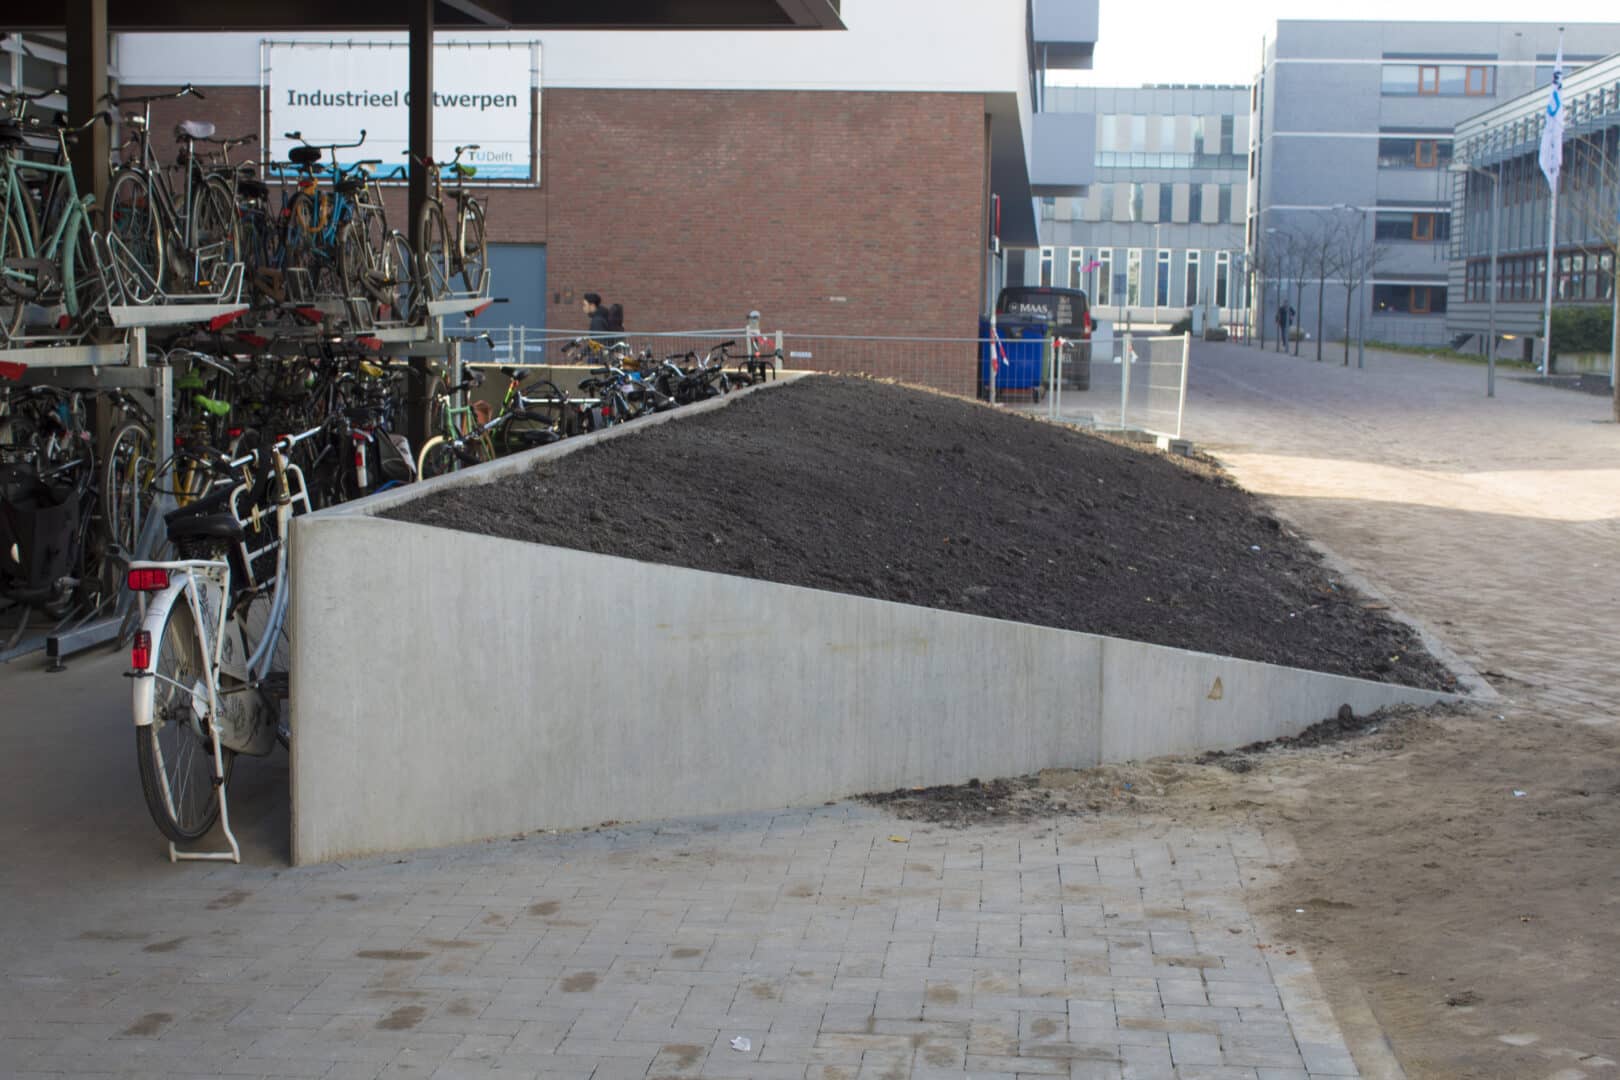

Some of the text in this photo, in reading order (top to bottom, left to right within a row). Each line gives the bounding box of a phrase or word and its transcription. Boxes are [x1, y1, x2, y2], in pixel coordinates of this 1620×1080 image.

[287, 89, 518, 110] Industrieel twerpen
[1020, 303, 1048, 314] MAAS
